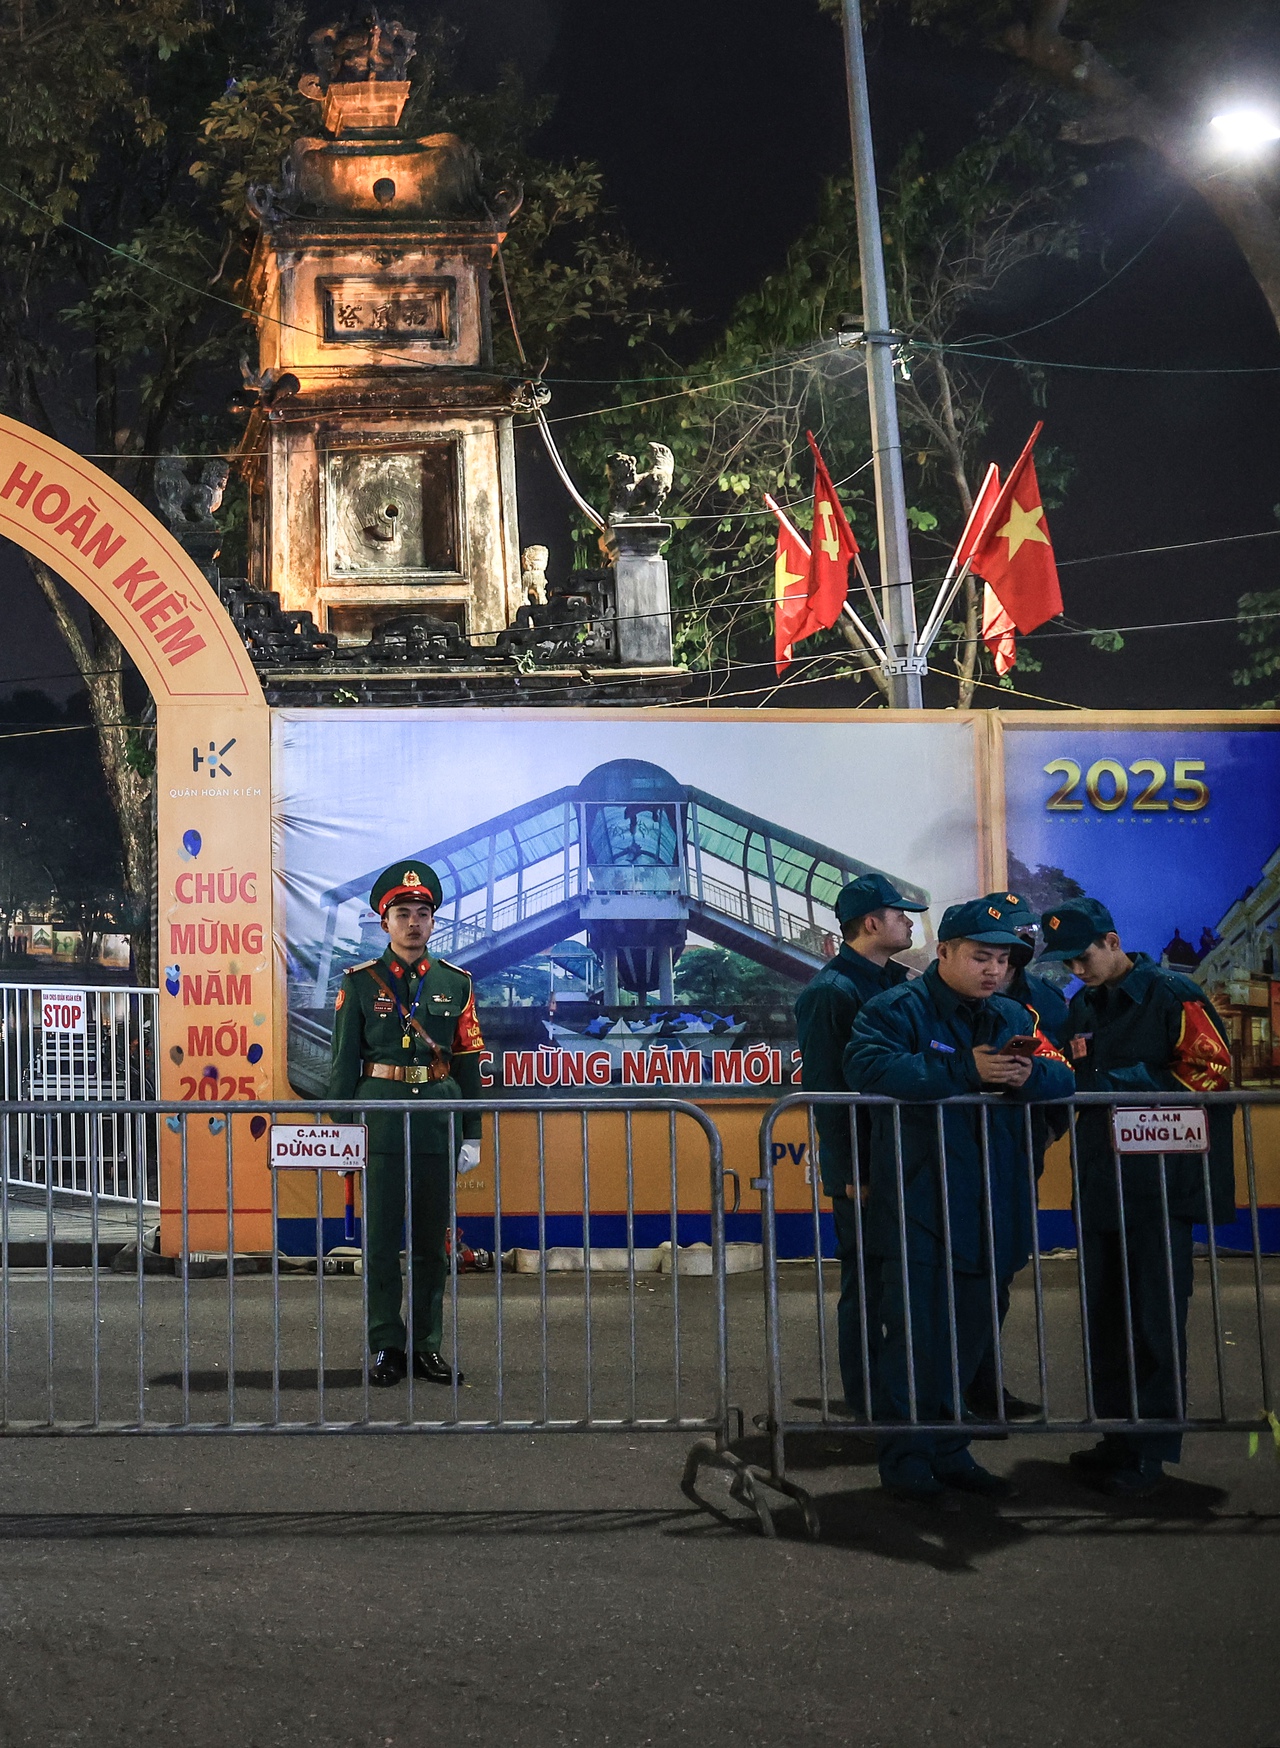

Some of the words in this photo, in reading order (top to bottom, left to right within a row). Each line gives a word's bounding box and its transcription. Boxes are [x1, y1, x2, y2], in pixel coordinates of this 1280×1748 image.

[0, 461, 127, 569] HOÀN
[112, 557, 207, 667] KIẾM
[1043, 757, 1210, 811] 2025
[175, 866, 257, 904] CHÚC
[170, 917, 263, 955] MỪNG
[182, 969, 252, 1006] NĂM
[43, 1003, 82, 1029] STOP
[187, 1019, 248, 1057] MỚI
[503, 1044, 612, 1087] MỪNG
[622, 1045, 702, 1086] NĂM
[712, 1043, 782, 1086] MỚI
[179, 1076, 257, 1100] 2025
[276, 1139, 327, 1157] DỪNG
[330, 1144, 360, 1160] LẠI
[296, 1129, 340, 1138] C.A.H.N
[1172, 1127, 1202, 1143] LẠI
